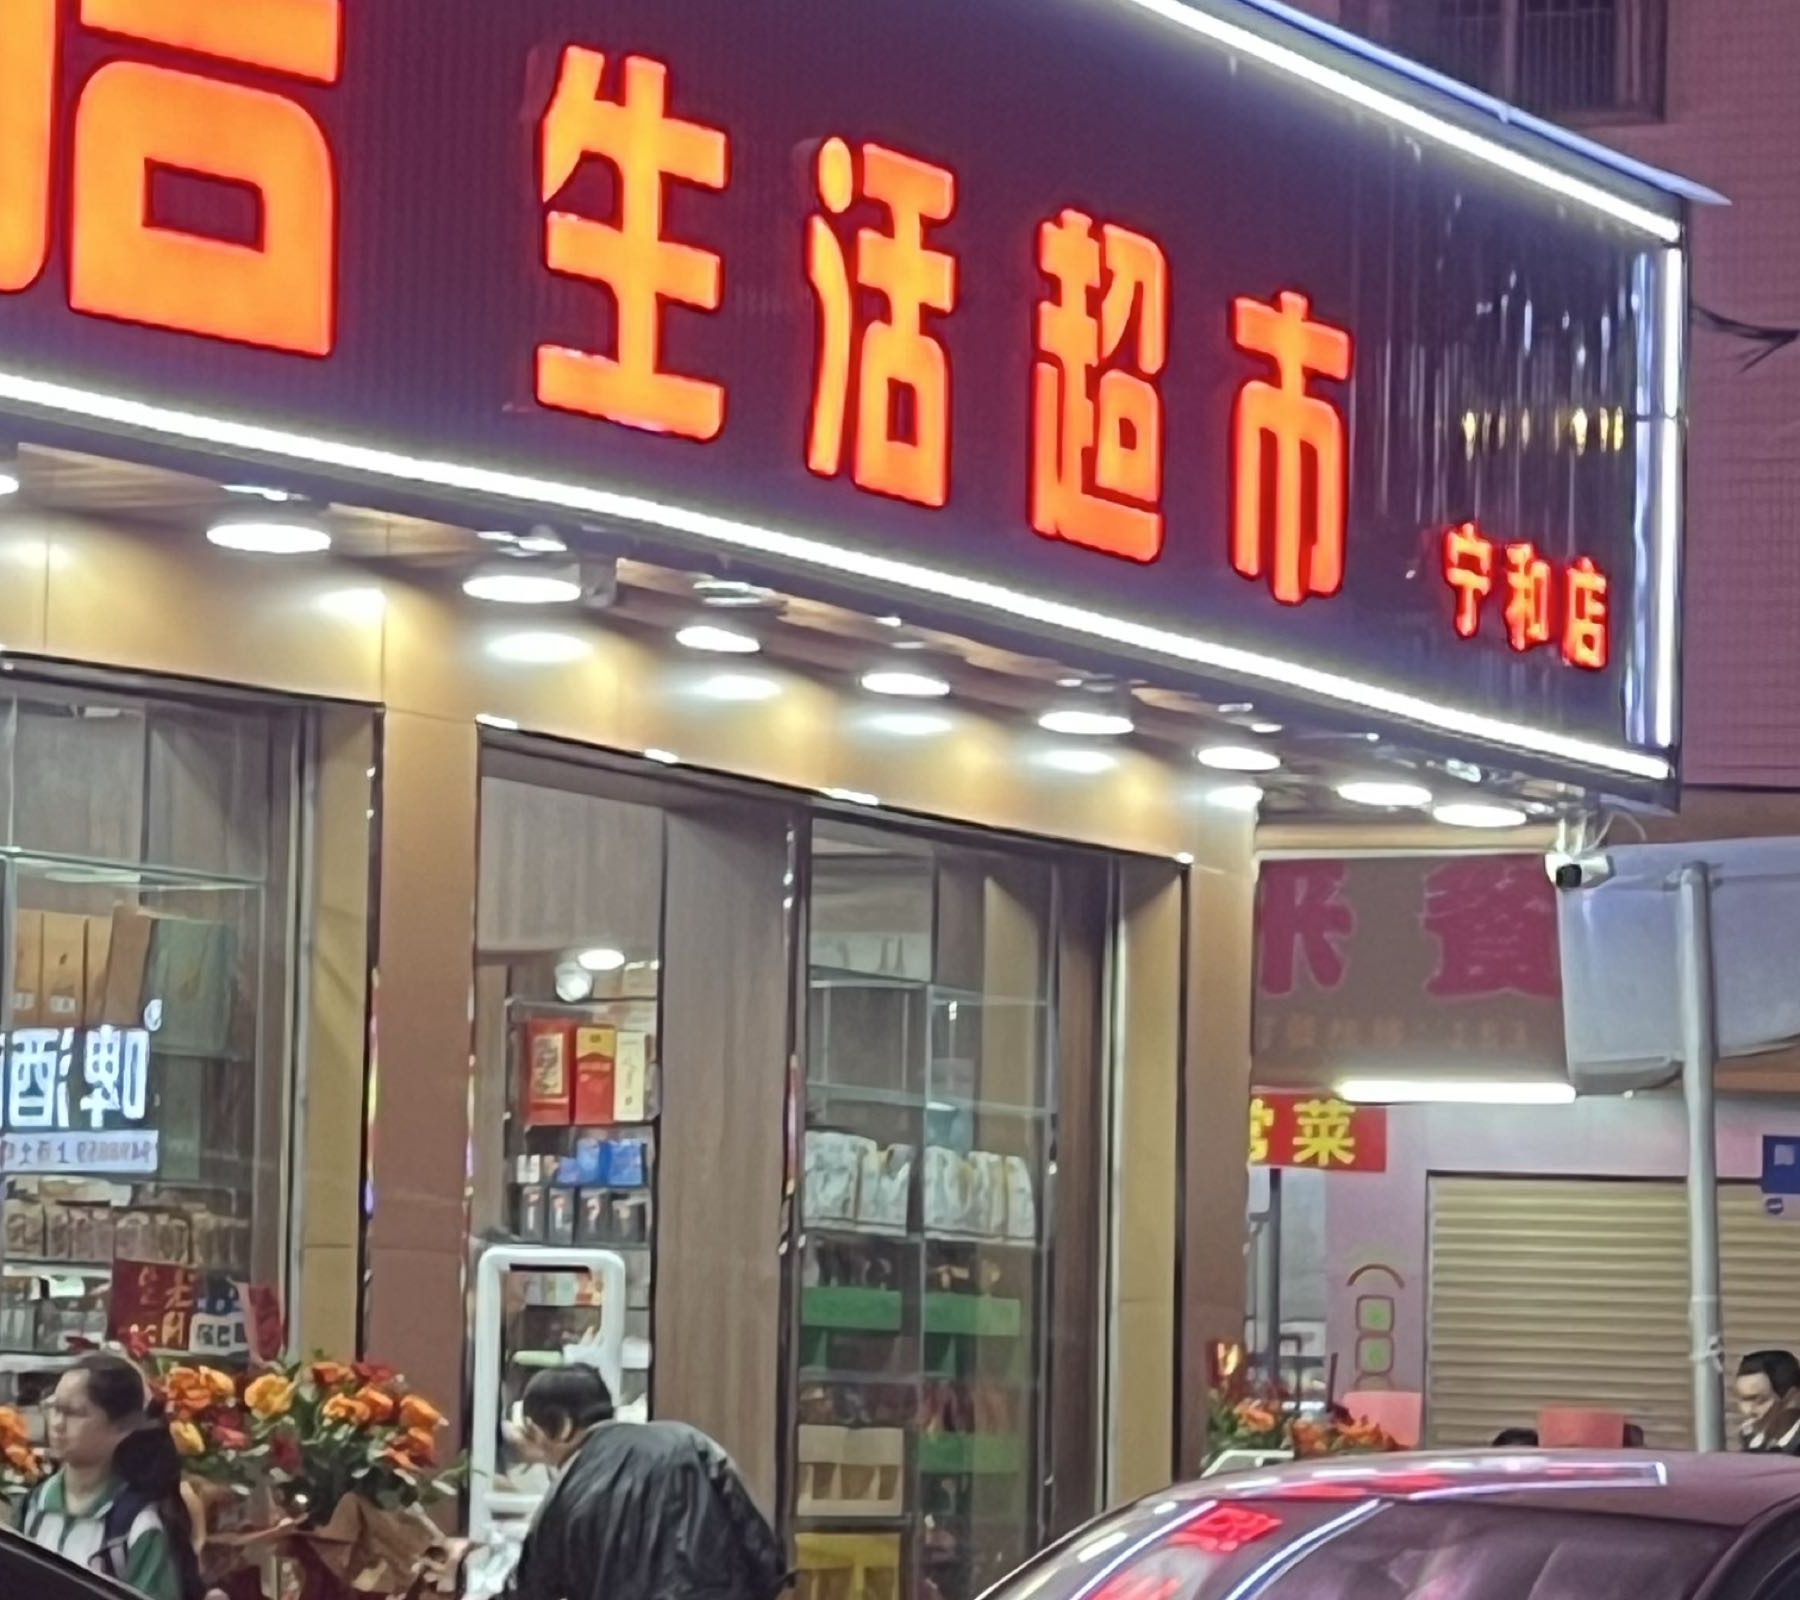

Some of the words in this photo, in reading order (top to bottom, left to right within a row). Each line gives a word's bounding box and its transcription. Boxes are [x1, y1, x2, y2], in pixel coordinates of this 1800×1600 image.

[535, 43, 1353, 603] 生活超市
[1442, 521, 1612, 671] 宁和店
